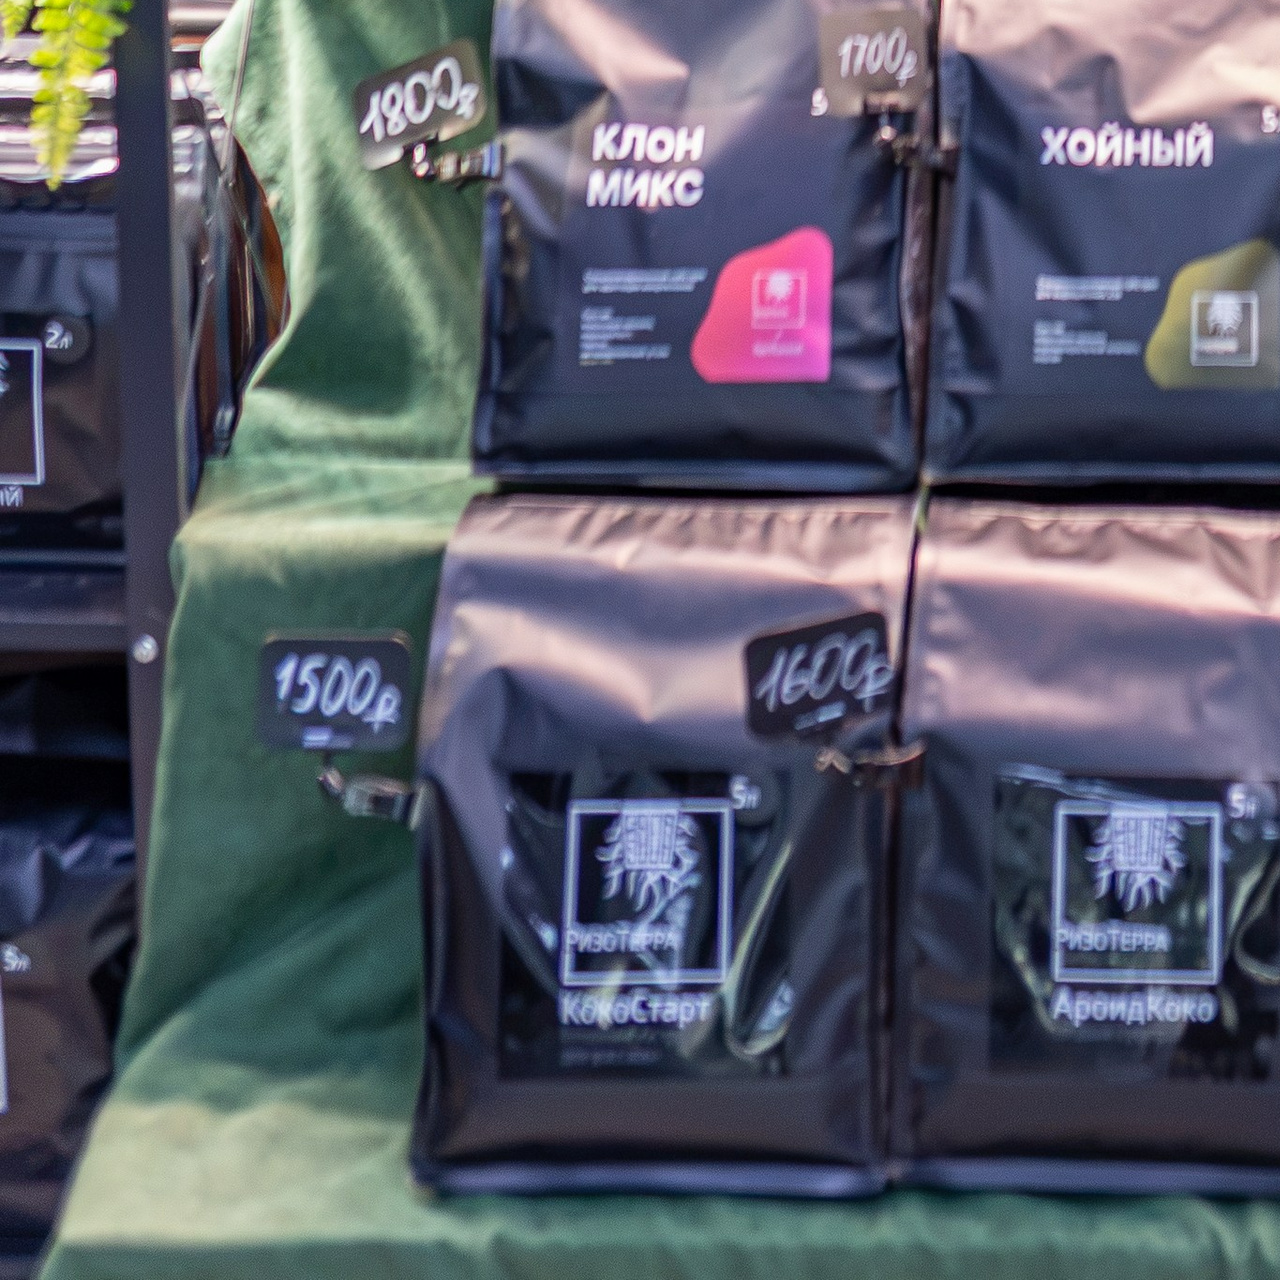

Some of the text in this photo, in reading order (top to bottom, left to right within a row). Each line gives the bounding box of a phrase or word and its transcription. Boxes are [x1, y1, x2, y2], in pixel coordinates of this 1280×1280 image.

[591, 123, 705, 163] КЛОН
[1040, 121, 1215, 167] ХОЙНЫЙ
[585, 167, 705, 208] МИКС
